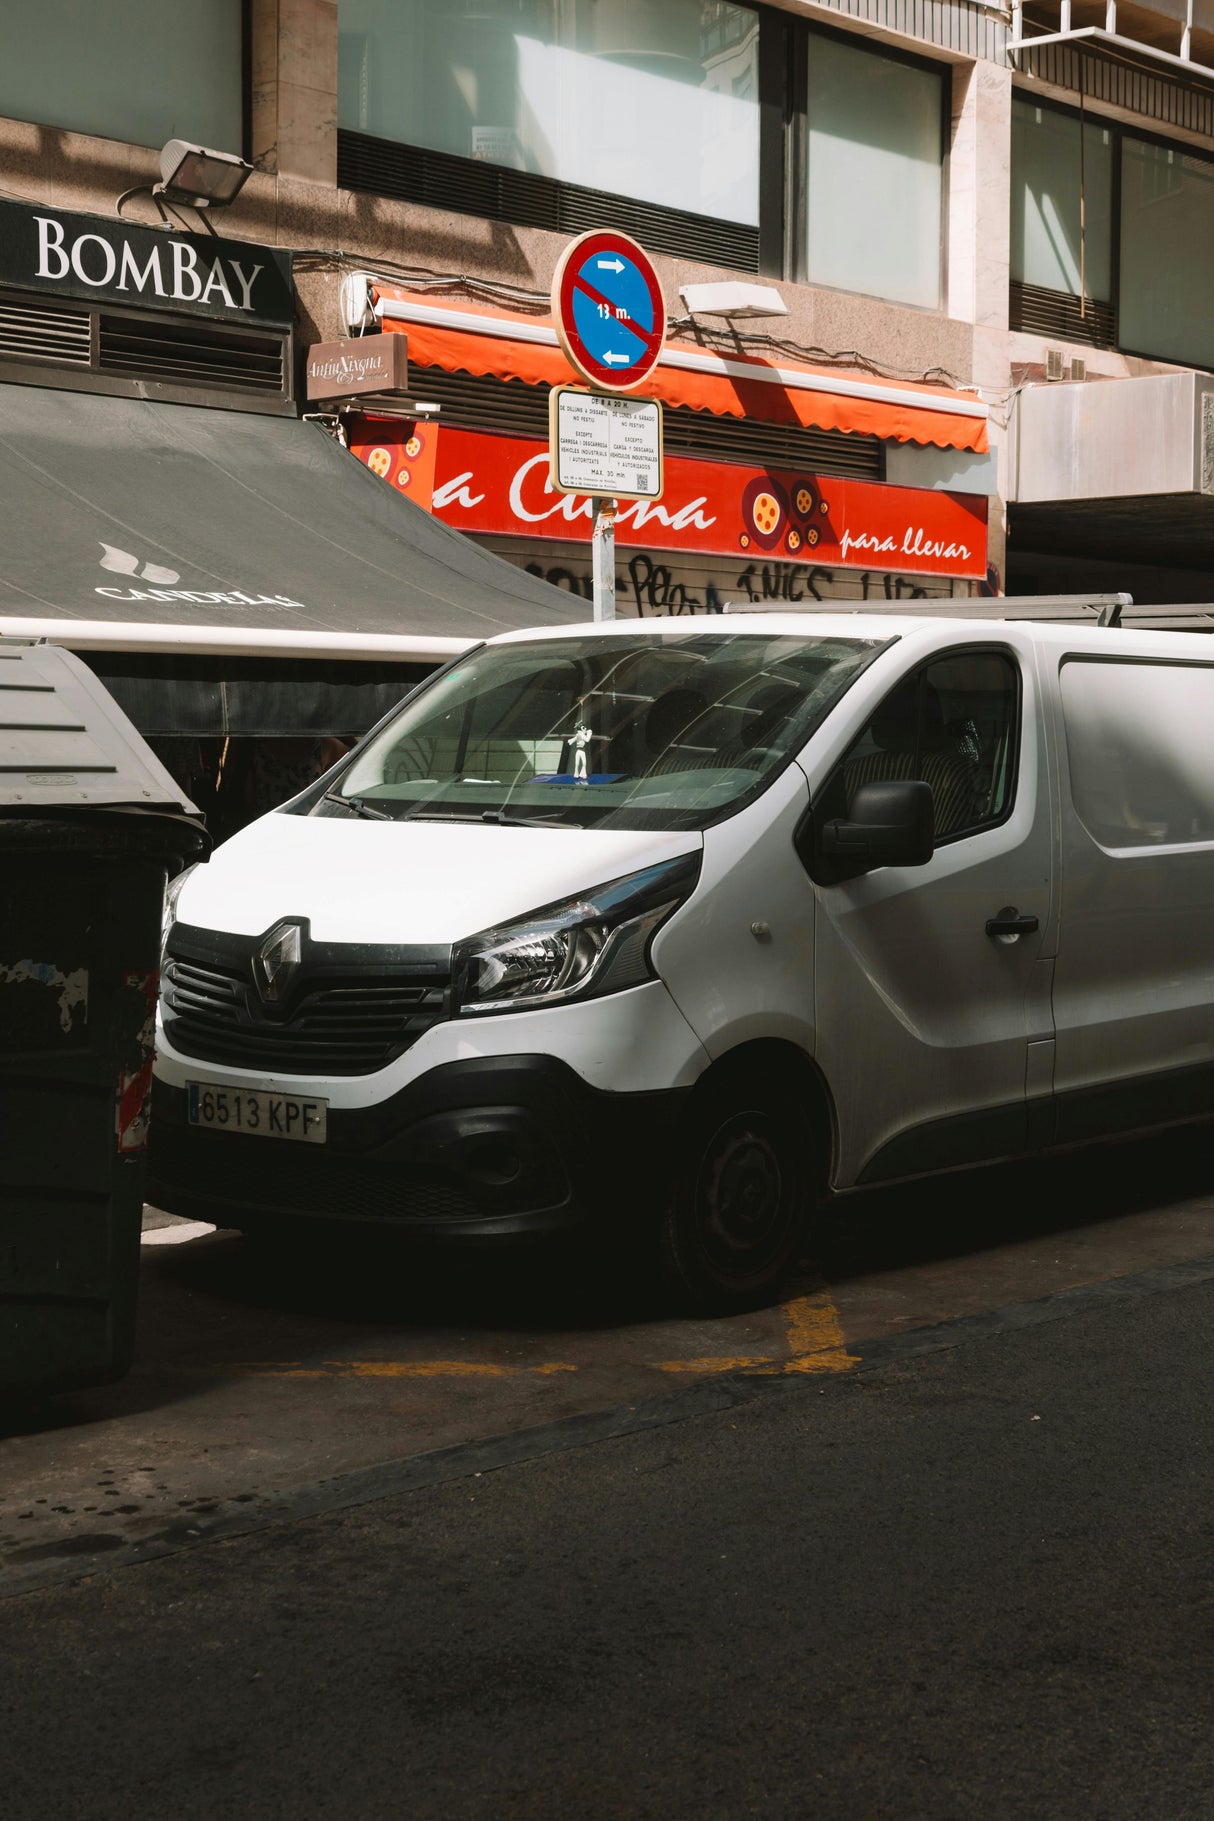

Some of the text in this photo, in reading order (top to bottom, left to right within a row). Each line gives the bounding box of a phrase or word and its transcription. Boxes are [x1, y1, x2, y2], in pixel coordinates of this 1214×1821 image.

[33, 216, 264, 311] BOMBAY
[597, 303, 630, 320] 13 m.
[614, 400, 621, 408] 20
[589, 408, 608, 416] DISSABTE
[582, 440, 608, 448] DESCARREGA
[581, 448, 607, 457] INDUSTRIALS
[633, 445, 654, 453] DESCARGA
[572, 457, 599, 465] AUTORITZATS
[631, 454, 657, 462] INDUSTRIALES
[622, 462, 651, 470] AUTORIZADOS
[509, 452, 716, 530] Cuna
[840, 526, 971, 560] para llevar
[94, 587, 305, 608] CANDELAS
[202, 1092, 318, 1135] 6513 KPF
